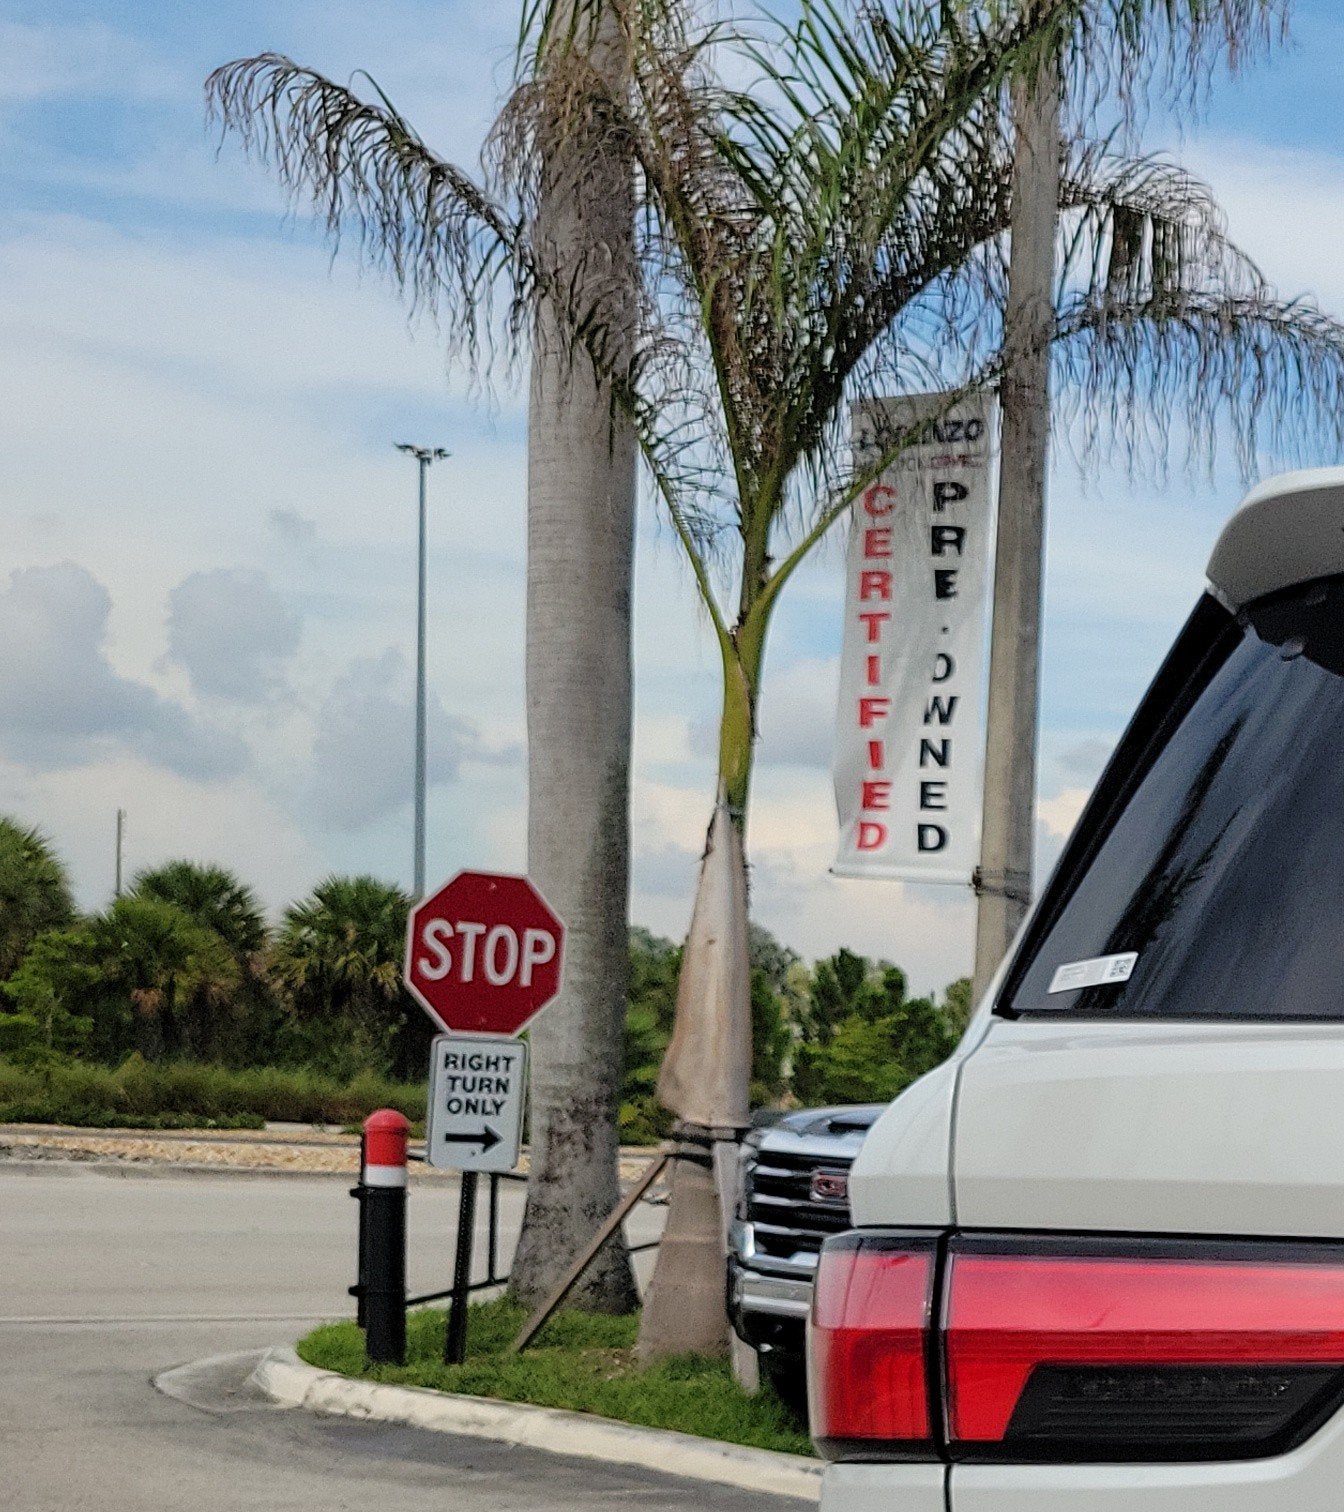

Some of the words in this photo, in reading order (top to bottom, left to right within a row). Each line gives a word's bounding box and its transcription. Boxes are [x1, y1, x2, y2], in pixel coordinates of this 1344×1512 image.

[857, 484, 897, 852] CERTIFIED
[417, 917, 556, 987] STOP
[444, 1053, 517, 1073] RIGHT
[446, 1075, 511, 1095] TURN
[446, 1098, 507, 1116] ONLY
